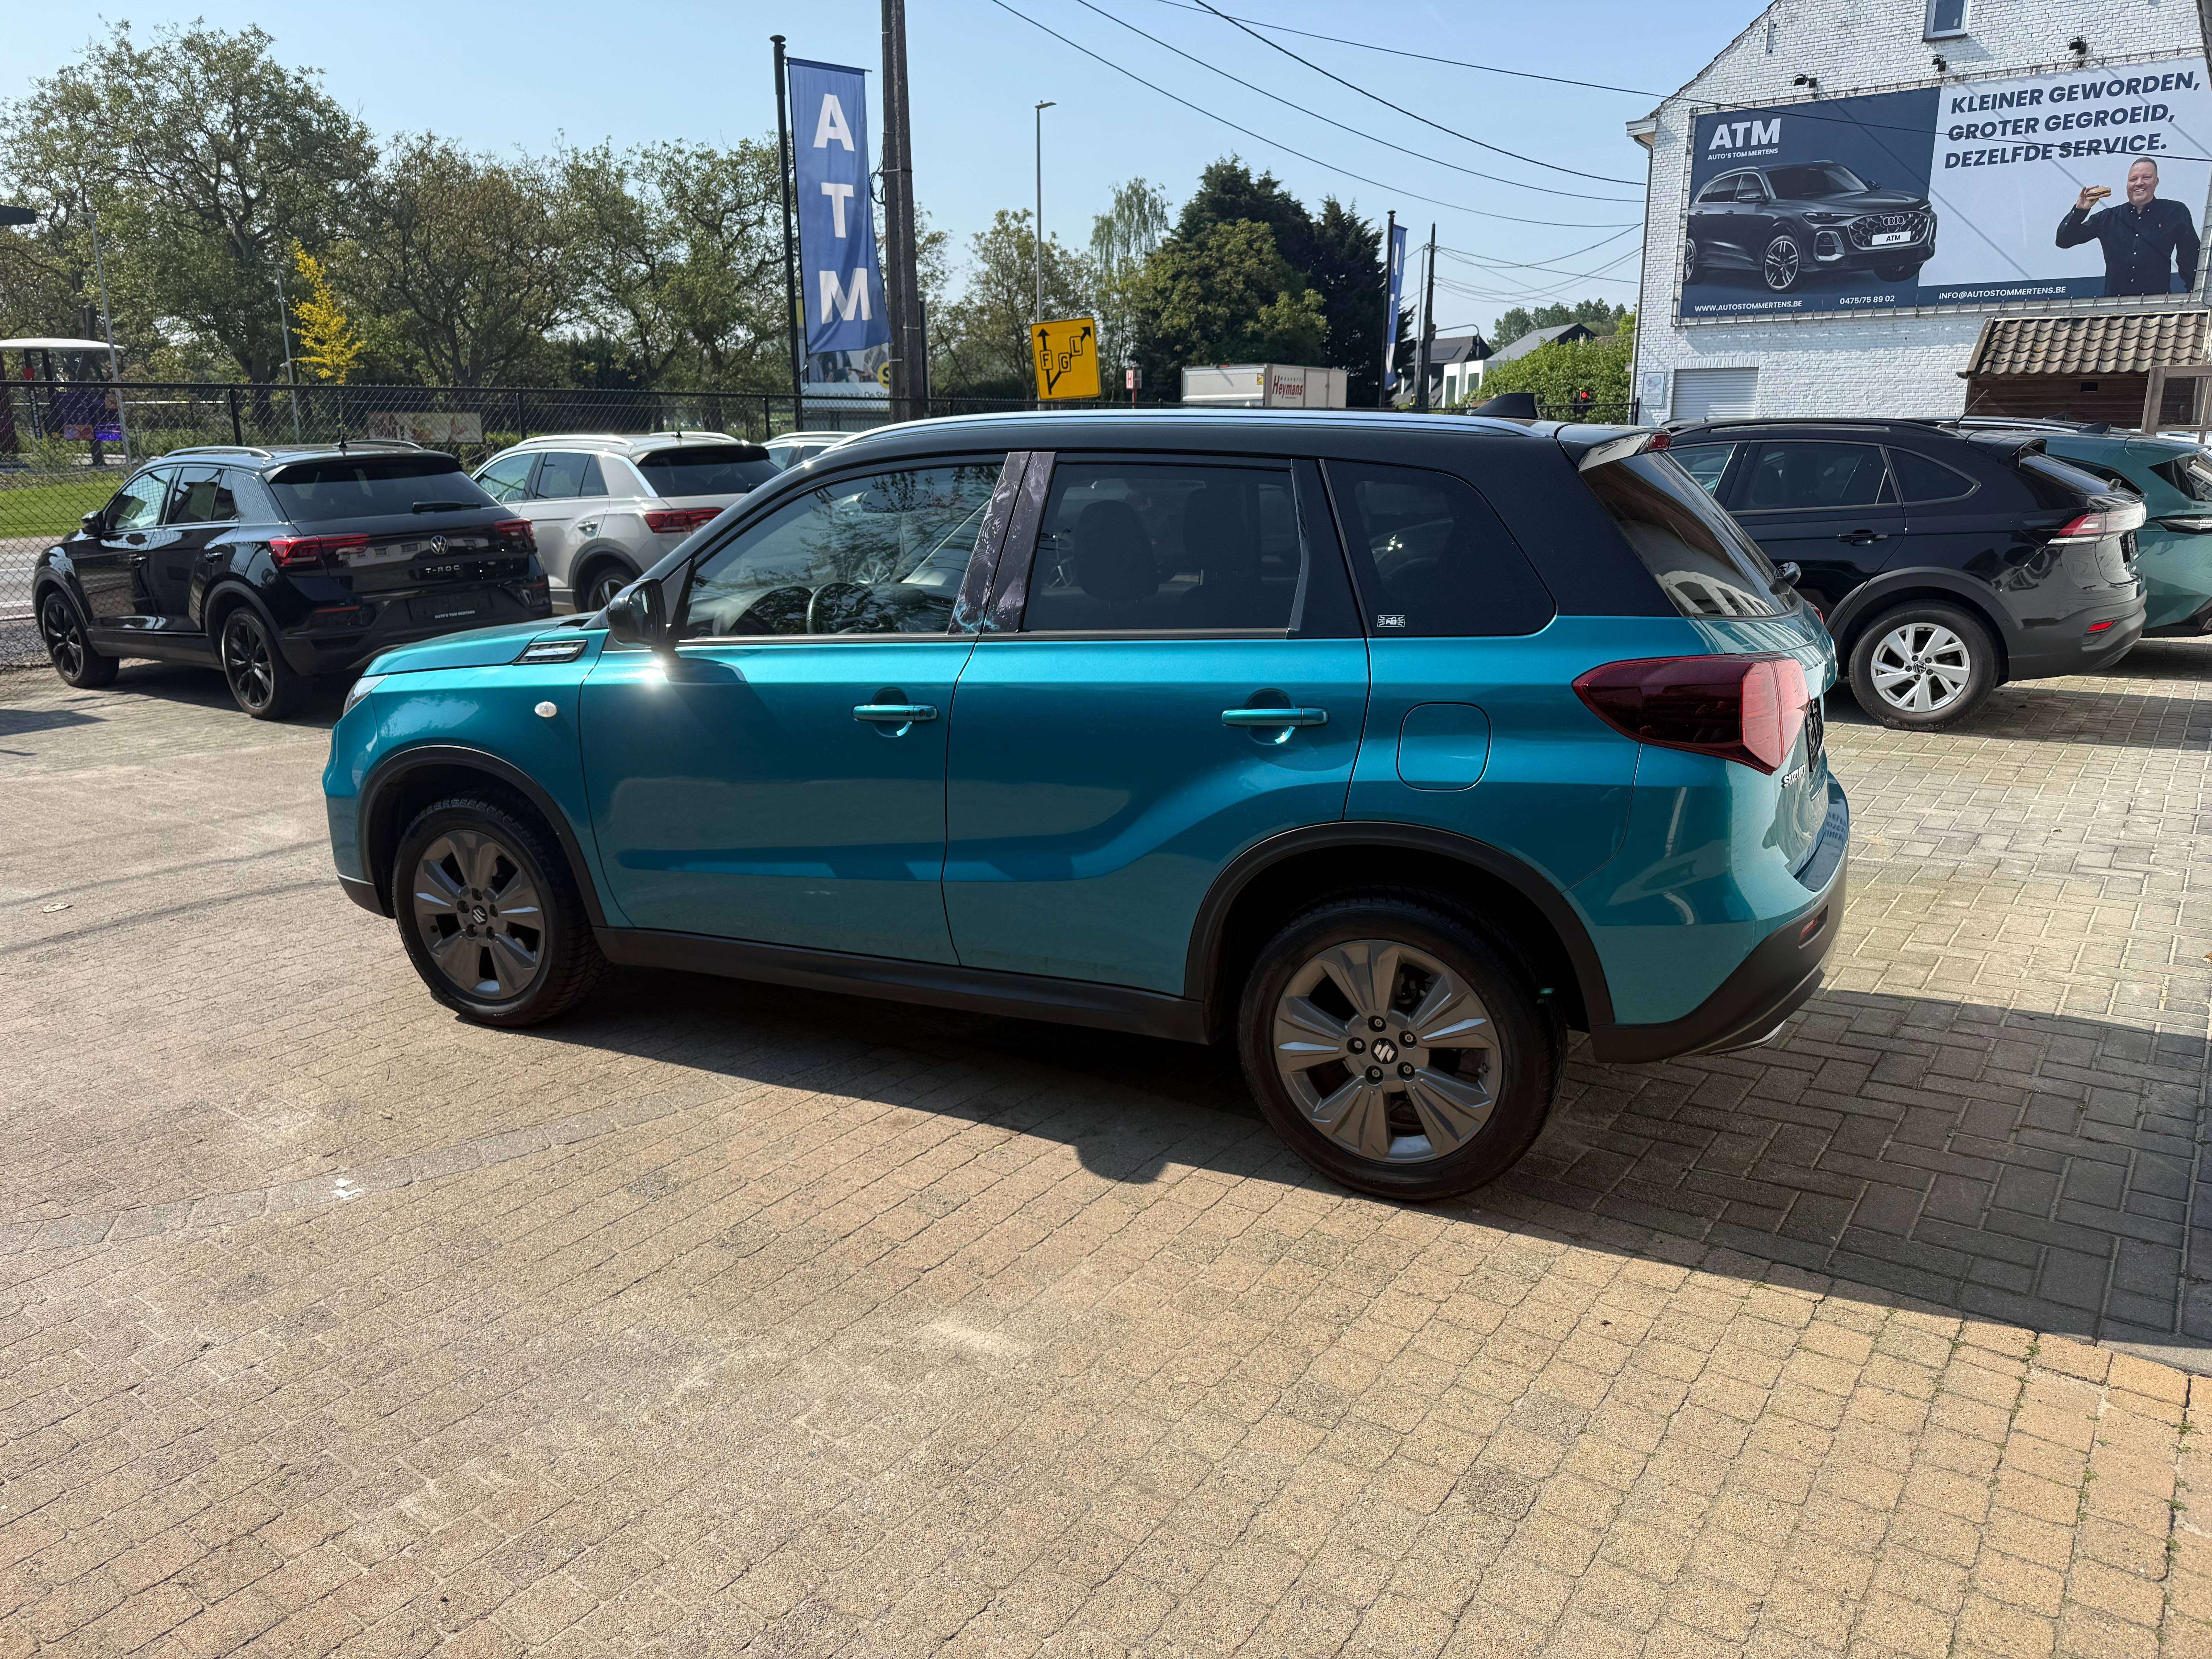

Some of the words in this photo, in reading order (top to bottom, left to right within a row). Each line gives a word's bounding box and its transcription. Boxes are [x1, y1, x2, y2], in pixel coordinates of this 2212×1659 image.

[1951, 89, 2044, 114] KLEINER
[2049, 71, 2200, 103] GEWORDEN,
[1948, 117, 2039, 141] GROTER
[2044, 104, 2175, 131] GEGROEID,
[1709, 118, 1781, 150] ATM
[1748, 148, 1778, 156] MERTENS
[1945, 143, 2054, 169] DEZELFDE
[2058, 133, 2167, 158] SERVICE.
[813, 94, 872, 325] ATM
[1939, 286, 2066, 299] INFO@AUTOSTOMMERTENS.BE
[1695, 301, 1802, 312] WWW.AUTOSTOMMERTENS.BE
[1072, 339, 1080, 353] L
[1043, 353, 1049, 367] F
[1061, 356, 1068, 369] G
[1272, 375, 1303, 399] Heymans
[425, 564, 460, 574] T-ROC
